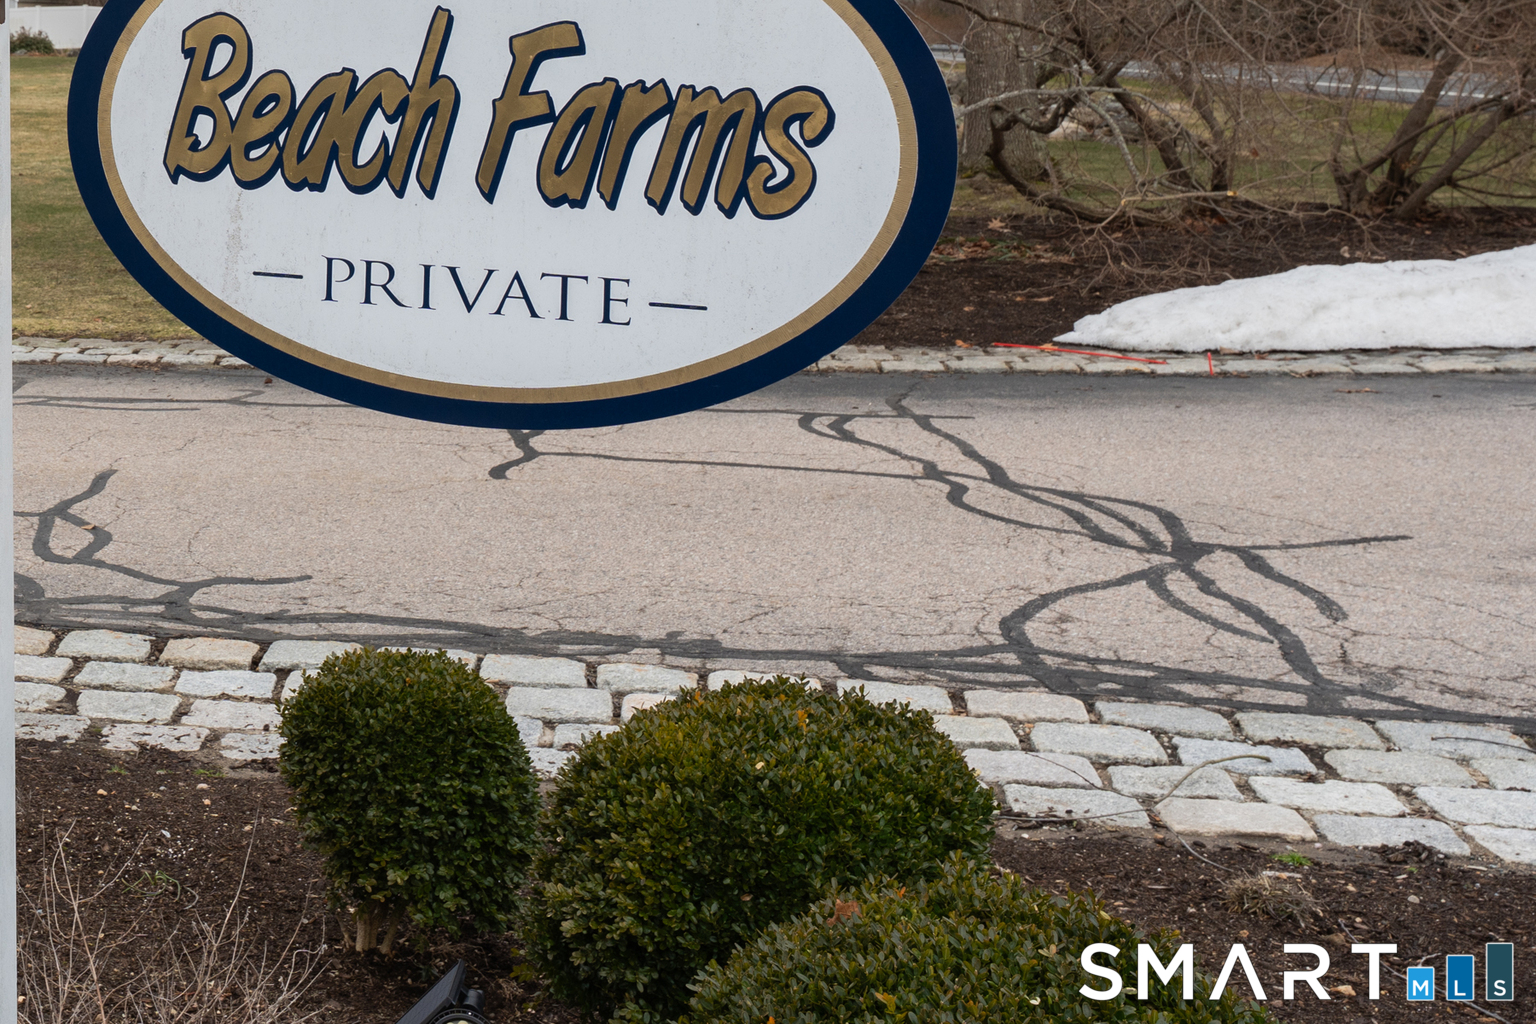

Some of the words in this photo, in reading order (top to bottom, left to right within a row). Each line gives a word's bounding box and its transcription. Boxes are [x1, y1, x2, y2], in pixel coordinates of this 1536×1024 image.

[164, 6, 460, 200] Beach
[475, 21, 836, 220] Farms
[321, 255, 632, 326] PRIVATE
